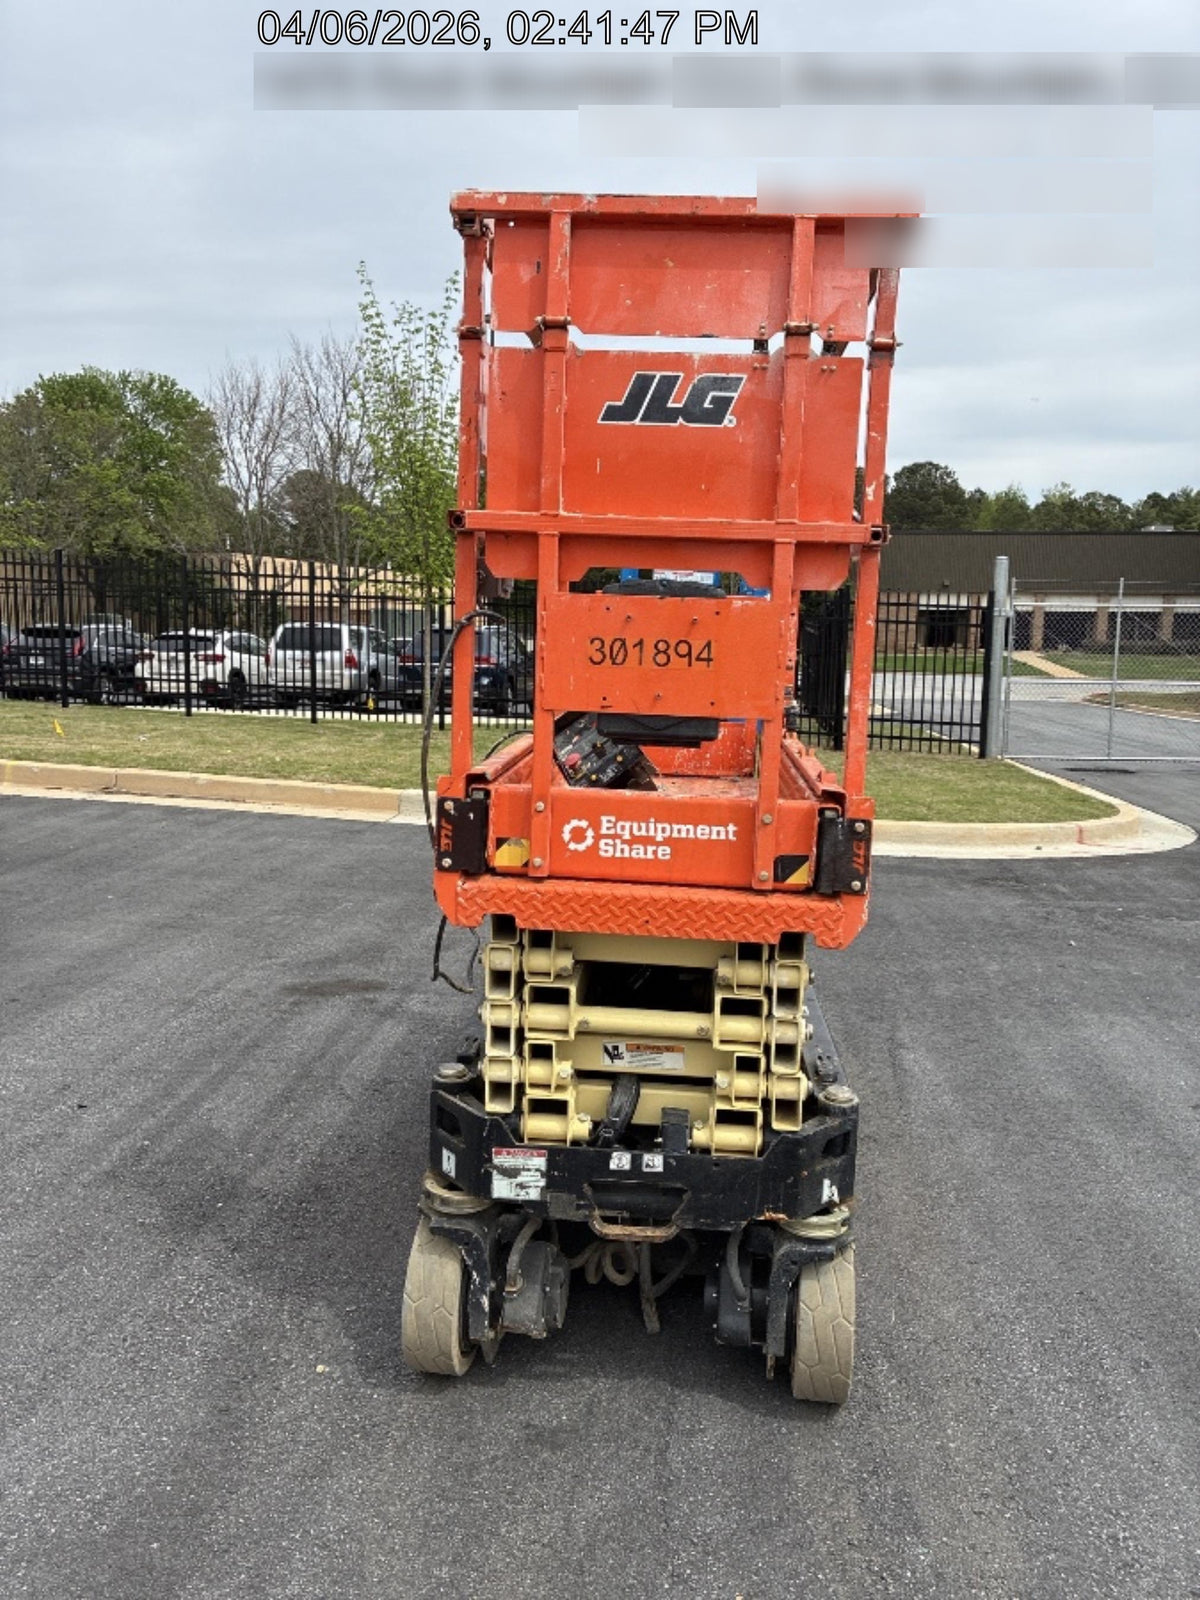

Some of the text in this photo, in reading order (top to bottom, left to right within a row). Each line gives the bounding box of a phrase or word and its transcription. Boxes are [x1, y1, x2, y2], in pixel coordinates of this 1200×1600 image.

[597, 371, 748, 428] JLG
[588, 637, 714, 668] 301894
[600, 815, 738, 841] Equipment
[598, 838, 672, 860] Share
